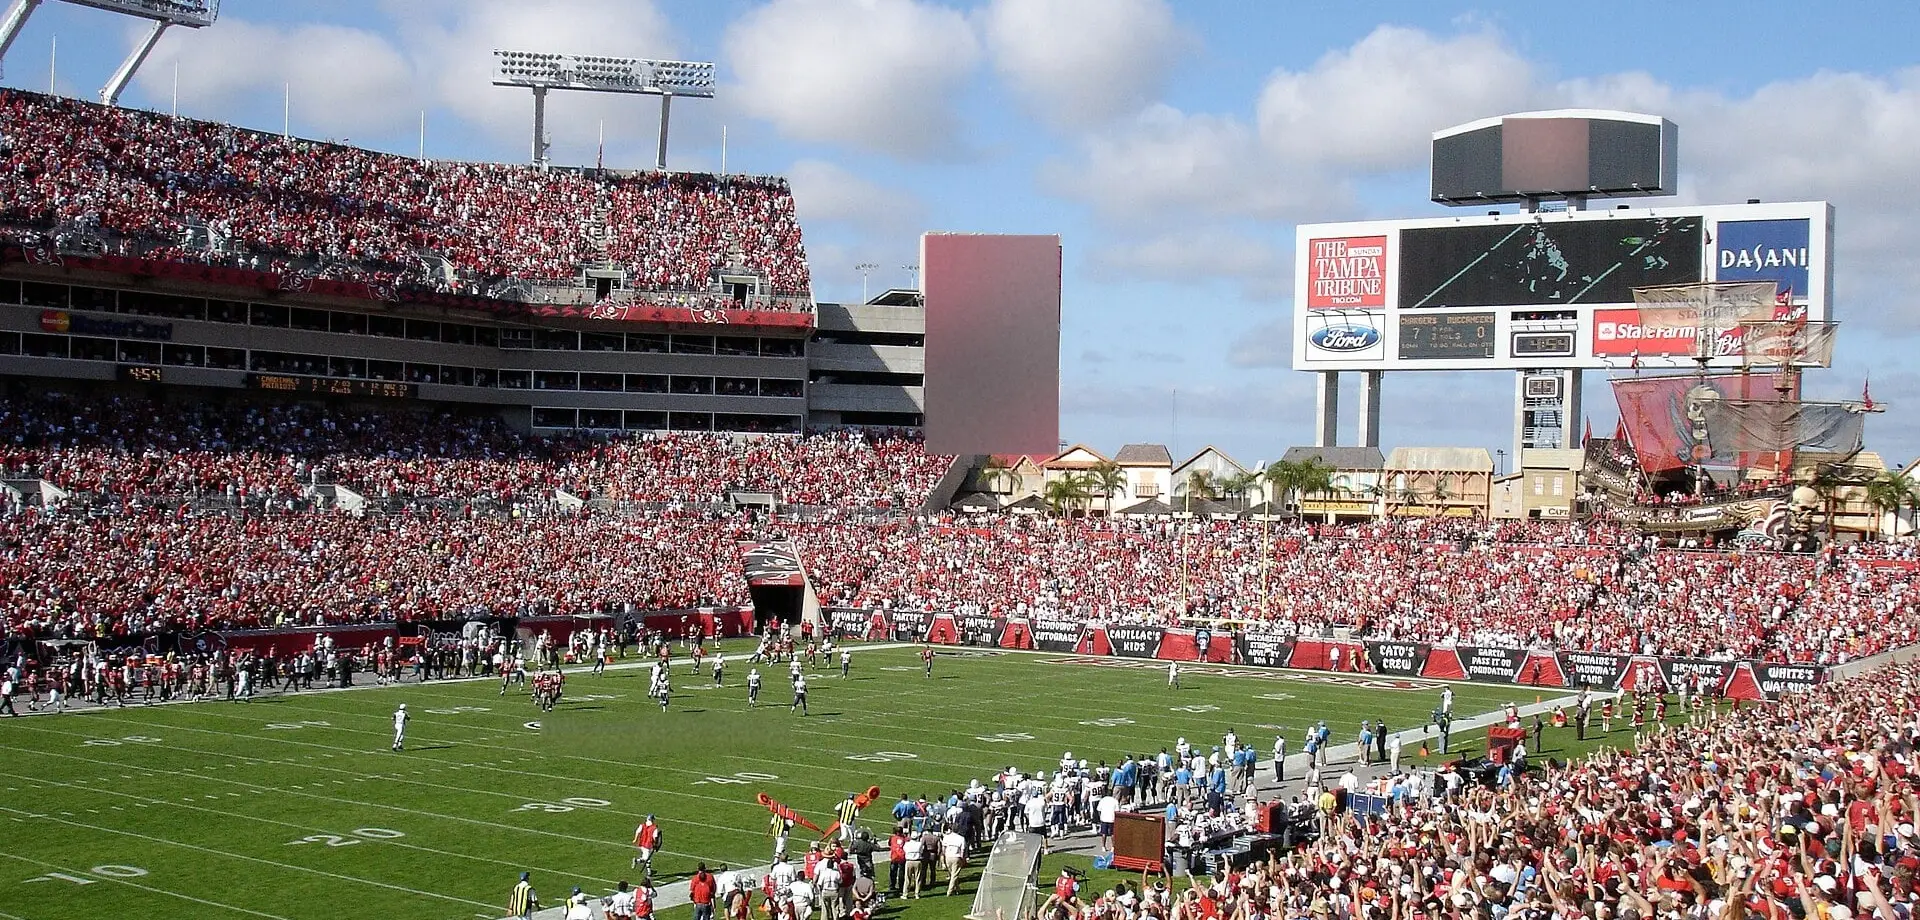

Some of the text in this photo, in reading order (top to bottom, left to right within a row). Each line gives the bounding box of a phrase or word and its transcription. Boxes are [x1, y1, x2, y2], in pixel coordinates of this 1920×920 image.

[1315, 241, 1347, 258] THE
[1720, 243, 1809, 272] DASANI
[1315, 257, 1380, 279] TAMPA
[1315, 279, 1381, 297] TRIBUNE
[1400, 315, 1494, 325] CHARGERS BUCCANEERS
[1322, 329, 1367, 348] Ford
[1412, 327, 1420, 340] 7
[1477, 326, 1485, 338] 0
[129, 367, 161, 381] 4:54
[261, 376, 299, 385] CARDINALS
[261, 383, 297, 391] PATRIOTS
[1109, 628, 1161, 641] CADILLAC'S
[1123, 640, 1145, 652] KIDS
[1379, 643, 1416, 657] CATO'S
[1478, 648, 1506, 658] GARCIA
[1253, 656, 1275, 665] BOAD
[1382, 656, 1413, 671] CREW
[1472, 657, 1512, 669] PASS IT ON
[1469, 667, 1515, 677] FOUNDATION
[1768, 666, 1815, 680] WHITE'S
[1054, 792, 1066, 802] 97
[520, 797, 611, 813] 30
[303, 828, 406, 847] 20
